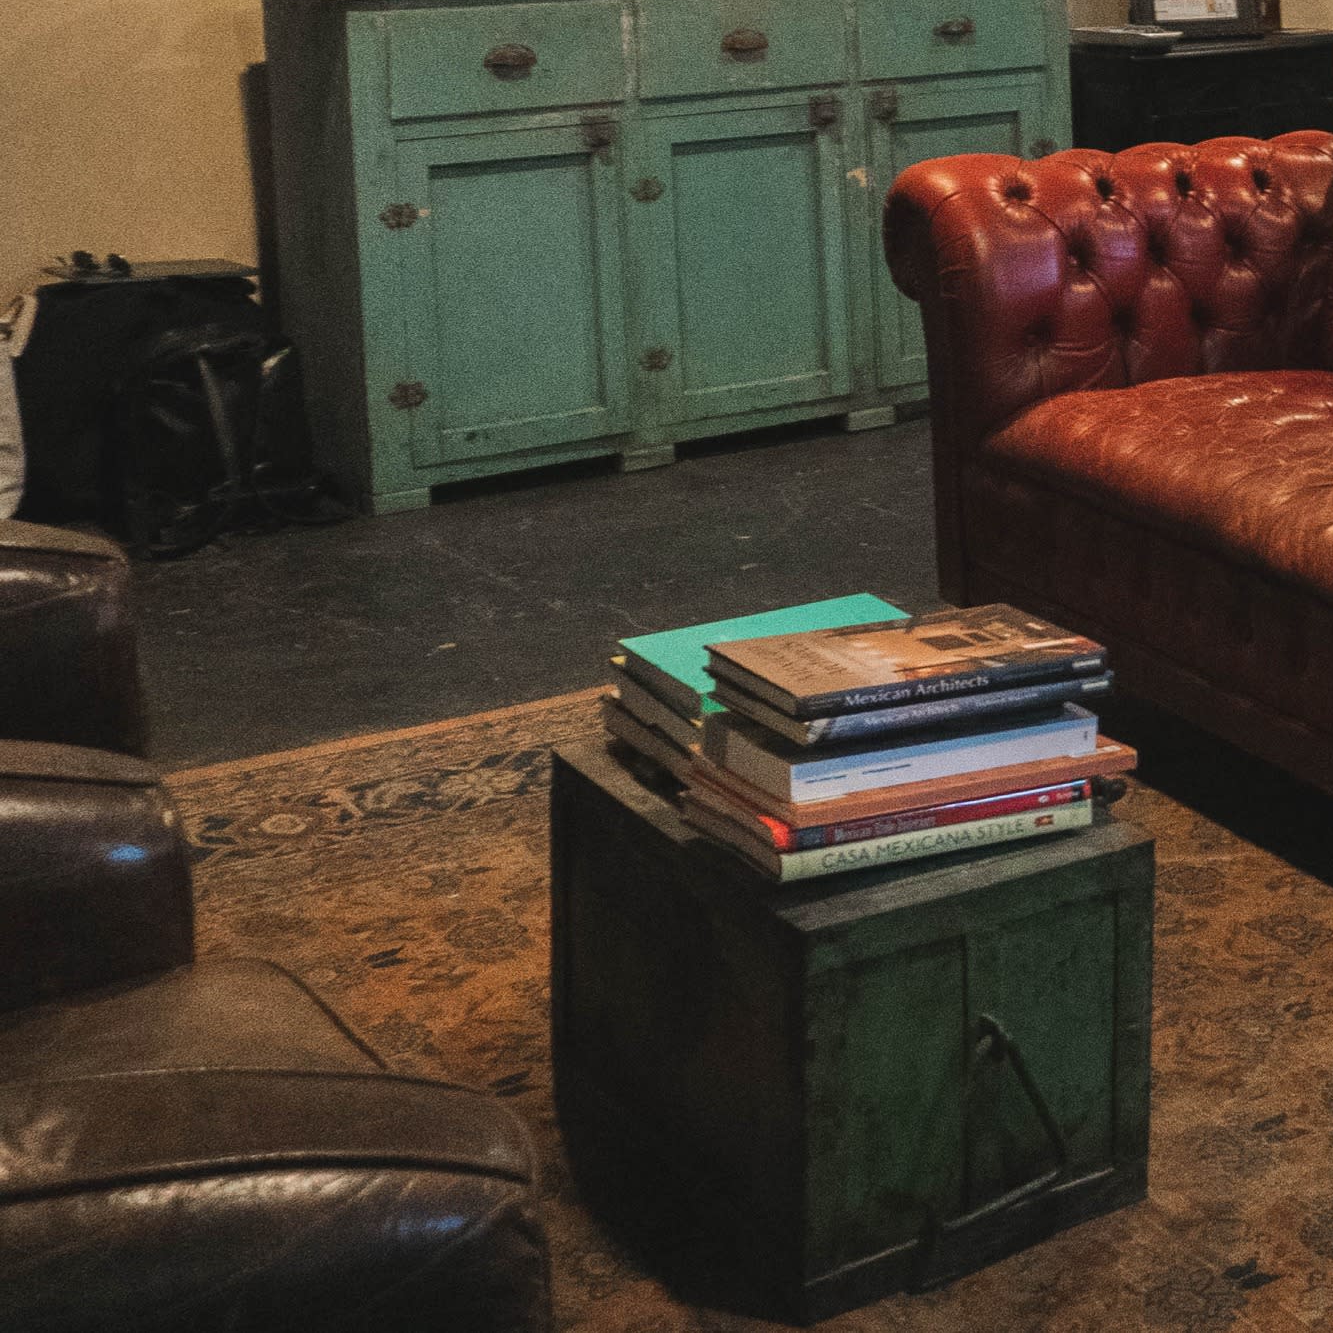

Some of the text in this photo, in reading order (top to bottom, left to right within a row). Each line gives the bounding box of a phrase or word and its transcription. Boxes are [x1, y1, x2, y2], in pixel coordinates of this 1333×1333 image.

[844, 675, 990, 706] Mexican Architects
[822, 818, 1025, 870] CASA MEXICANA STYLE
